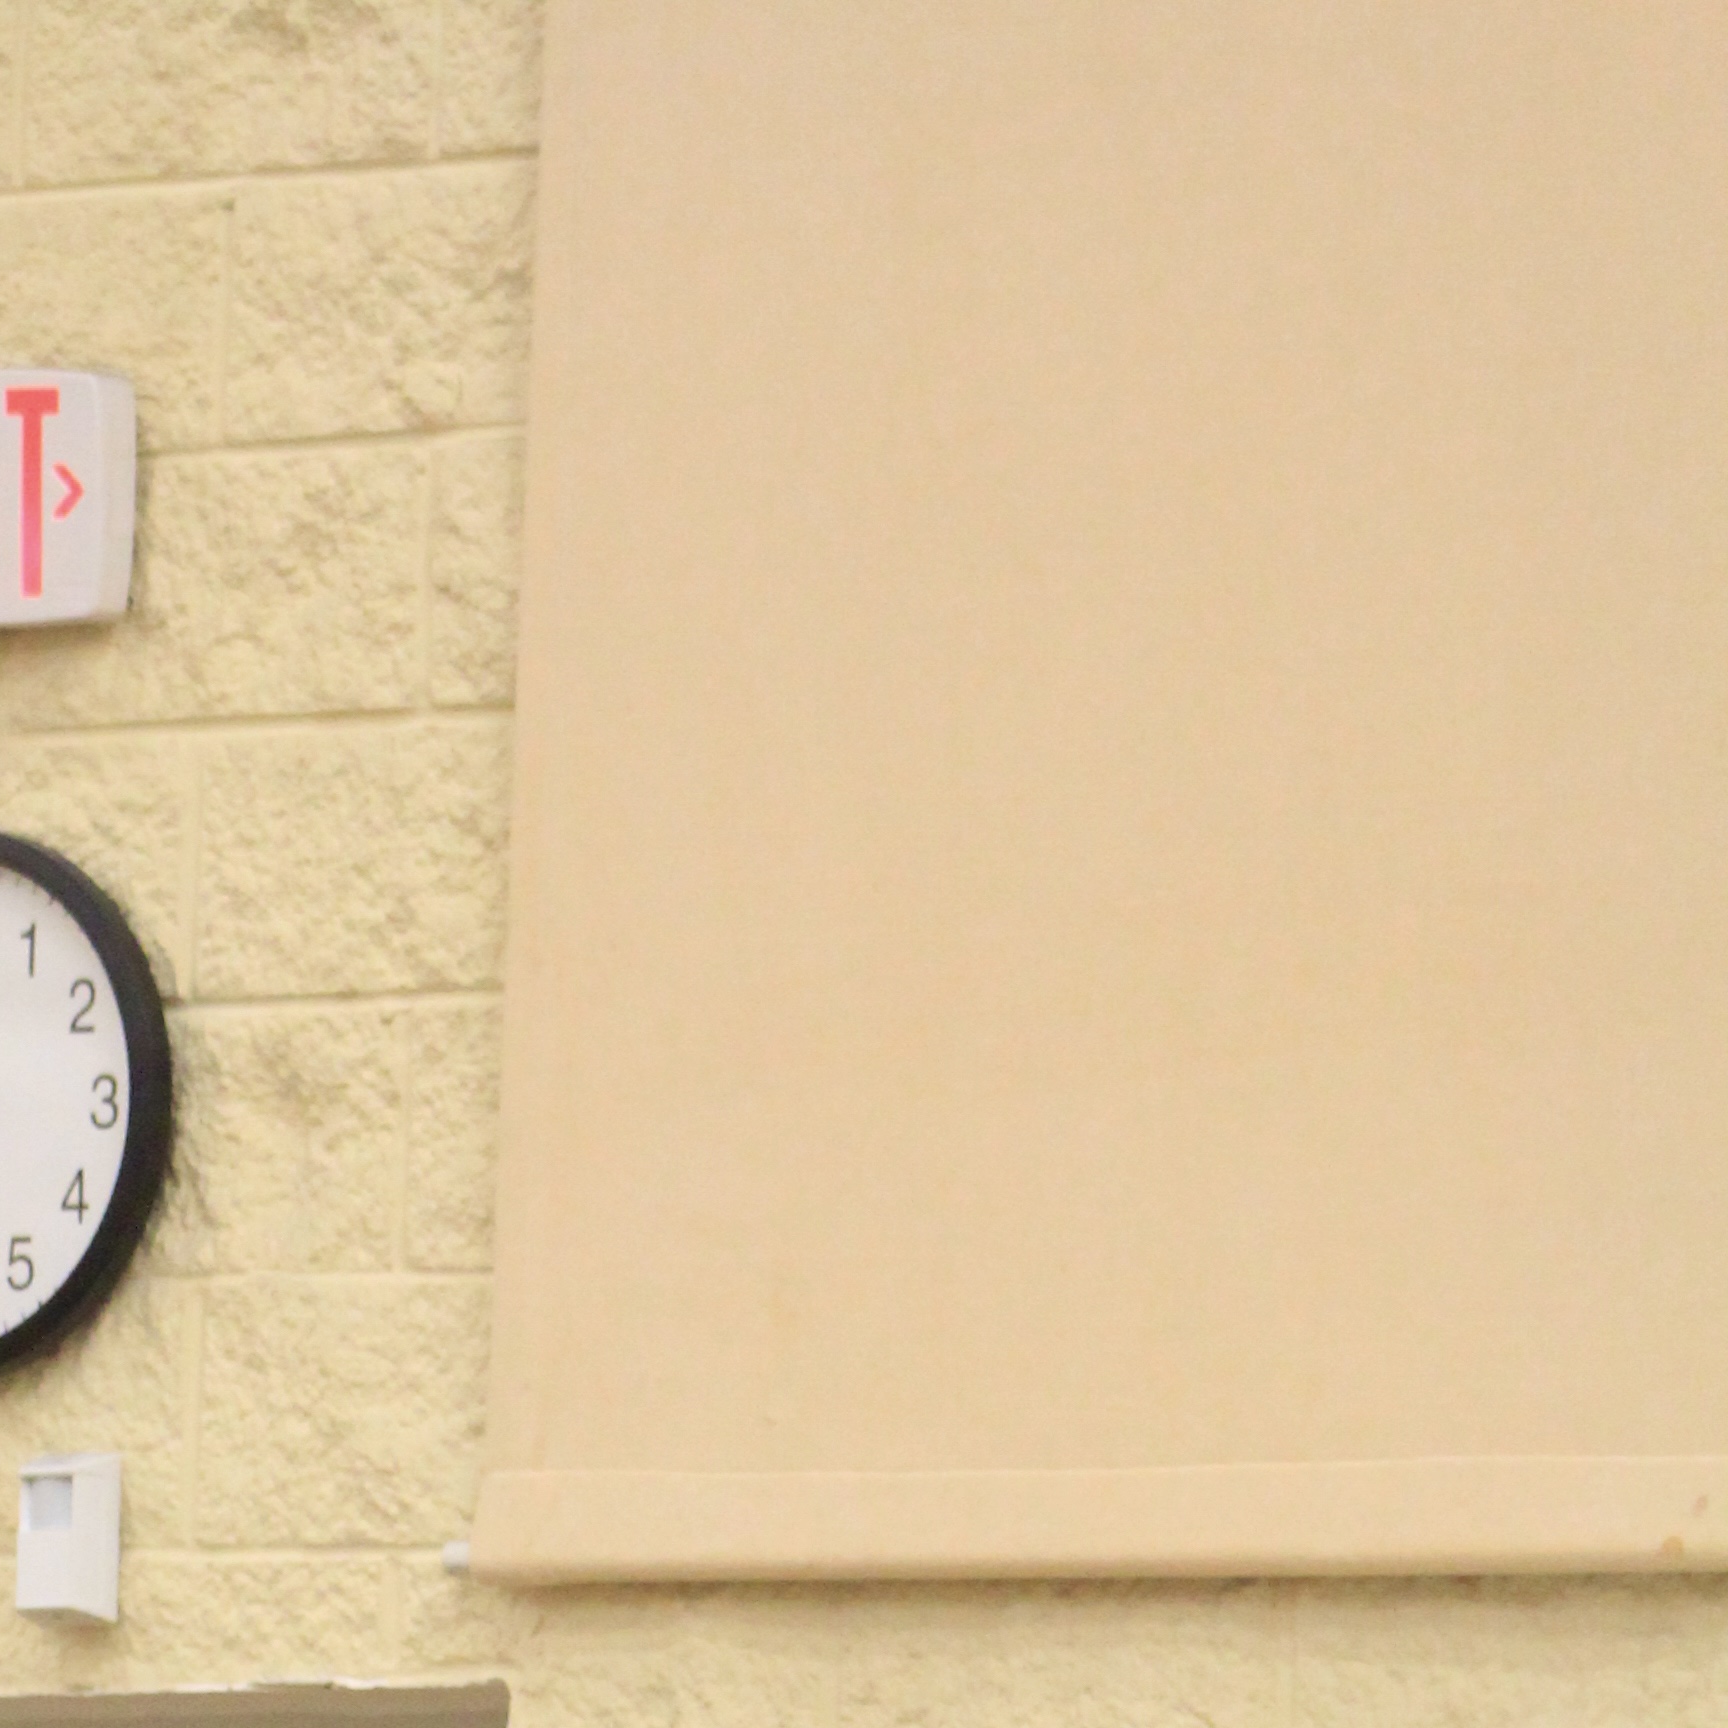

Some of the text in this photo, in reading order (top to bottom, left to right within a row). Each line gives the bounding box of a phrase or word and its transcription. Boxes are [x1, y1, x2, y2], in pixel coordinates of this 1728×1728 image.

[20, 922, 37, 978] 1
[69, 977, 97, 1034] 2
[90, 1073, 120, 1130] 3
[60, 1168, 89, 1225] 4
[6, 1235, 35, 1292] 5
